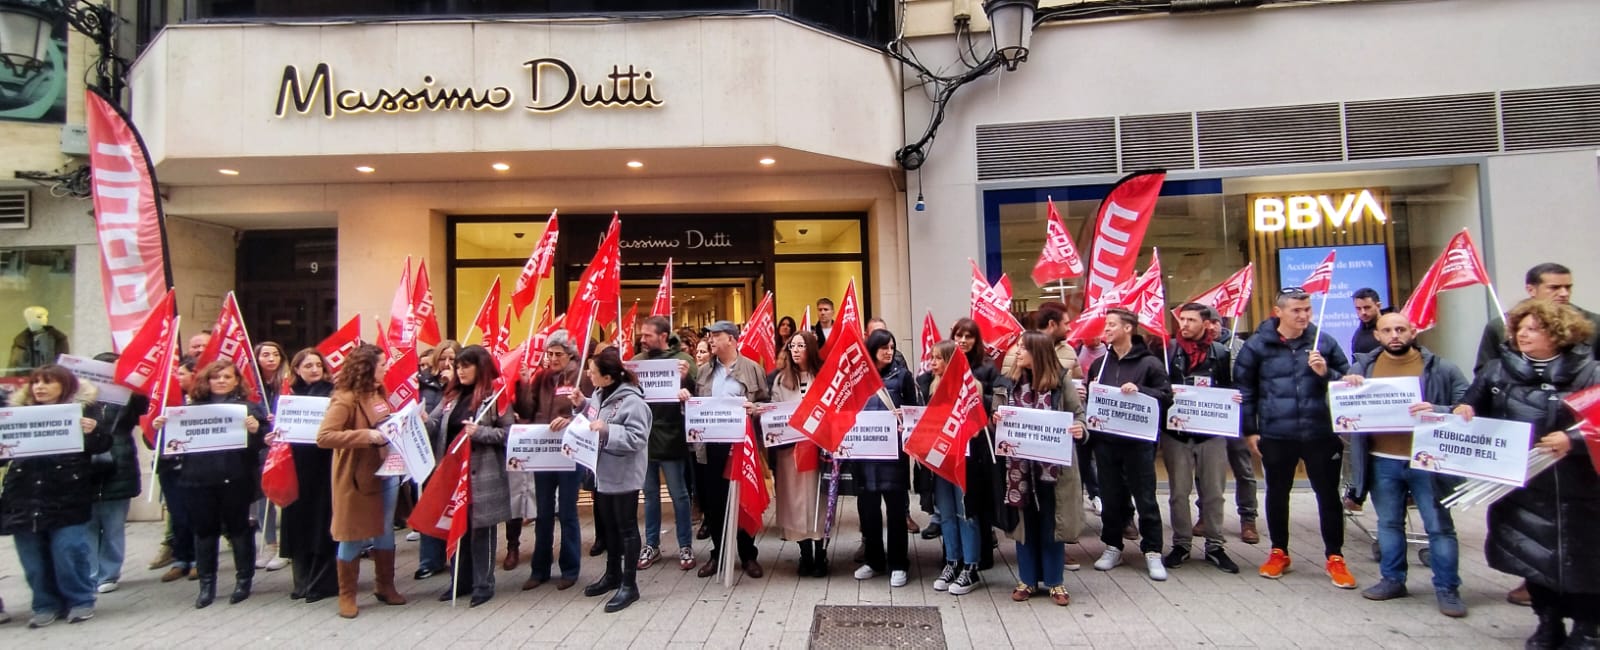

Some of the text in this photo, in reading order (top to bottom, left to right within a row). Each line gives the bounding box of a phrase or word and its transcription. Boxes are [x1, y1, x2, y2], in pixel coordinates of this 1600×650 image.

[274, 57, 663, 118] Massimo Dutti
[1254, 189, 1387, 232] BBVA
[686, 229, 732, 249] Dutti
[310, 261, 319, 273] 9
[1095, 396, 1118, 407] INDITEX
[1120, 400, 1145, 413] DESPIDE
[1175, 399, 1197, 407] VUESTRO
[1198, 401, 1223, 410] BENEFICIO
[1097, 408, 1149, 424] SUS EMPLEADOS
[1177, 408, 1228, 419] NUESTRO SACRIFICIO
[30, 420, 62, 429] BENEFICIO
[180, 417, 223, 427] REUBICACIÓN
[1021, 423, 1043, 432] APRENDE
[2, 429, 69, 439] NUESTRO SACRIFICIO
[185, 428, 210, 436] CIUDAD
[1008, 429, 1013, 437] ÉL
[1015, 431, 1027, 439] ABRE
[1040, 434, 1061, 443] CHAPAS
[1433, 429, 1507, 448] REUBICACIÓN EN
[1439, 443, 1497, 460] CIUDAD REAL
